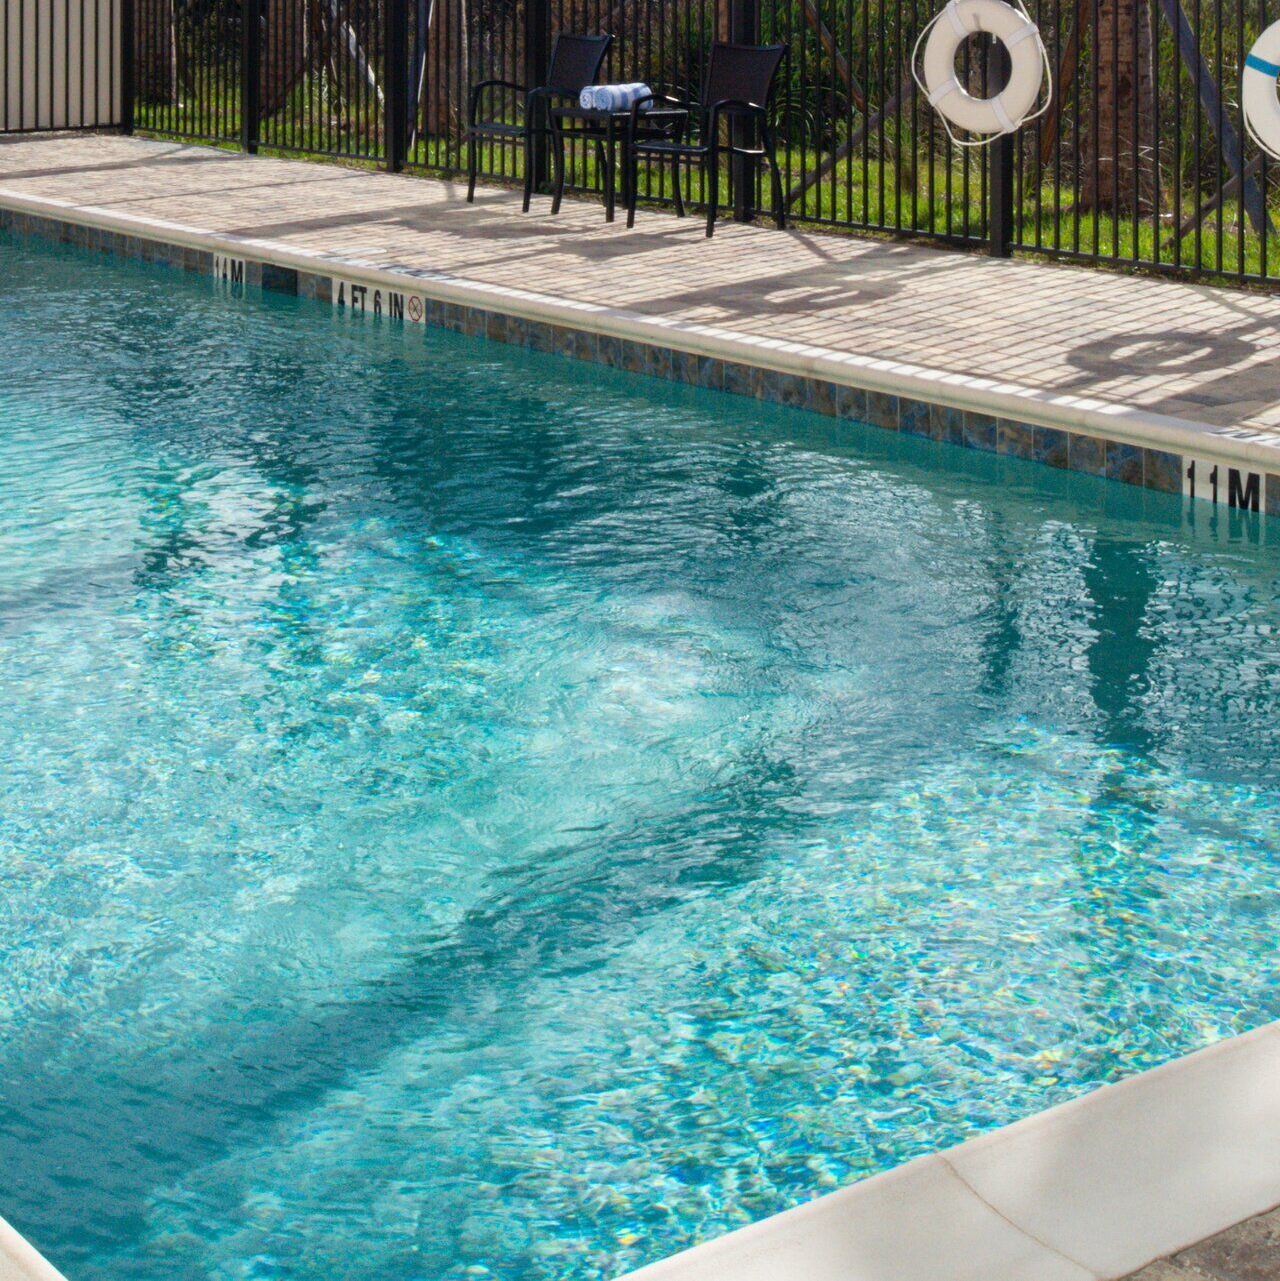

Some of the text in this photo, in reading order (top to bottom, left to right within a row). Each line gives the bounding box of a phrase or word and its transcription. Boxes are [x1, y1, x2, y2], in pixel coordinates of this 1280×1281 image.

[338, 282, 404, 319] 4 FT 6 IN
